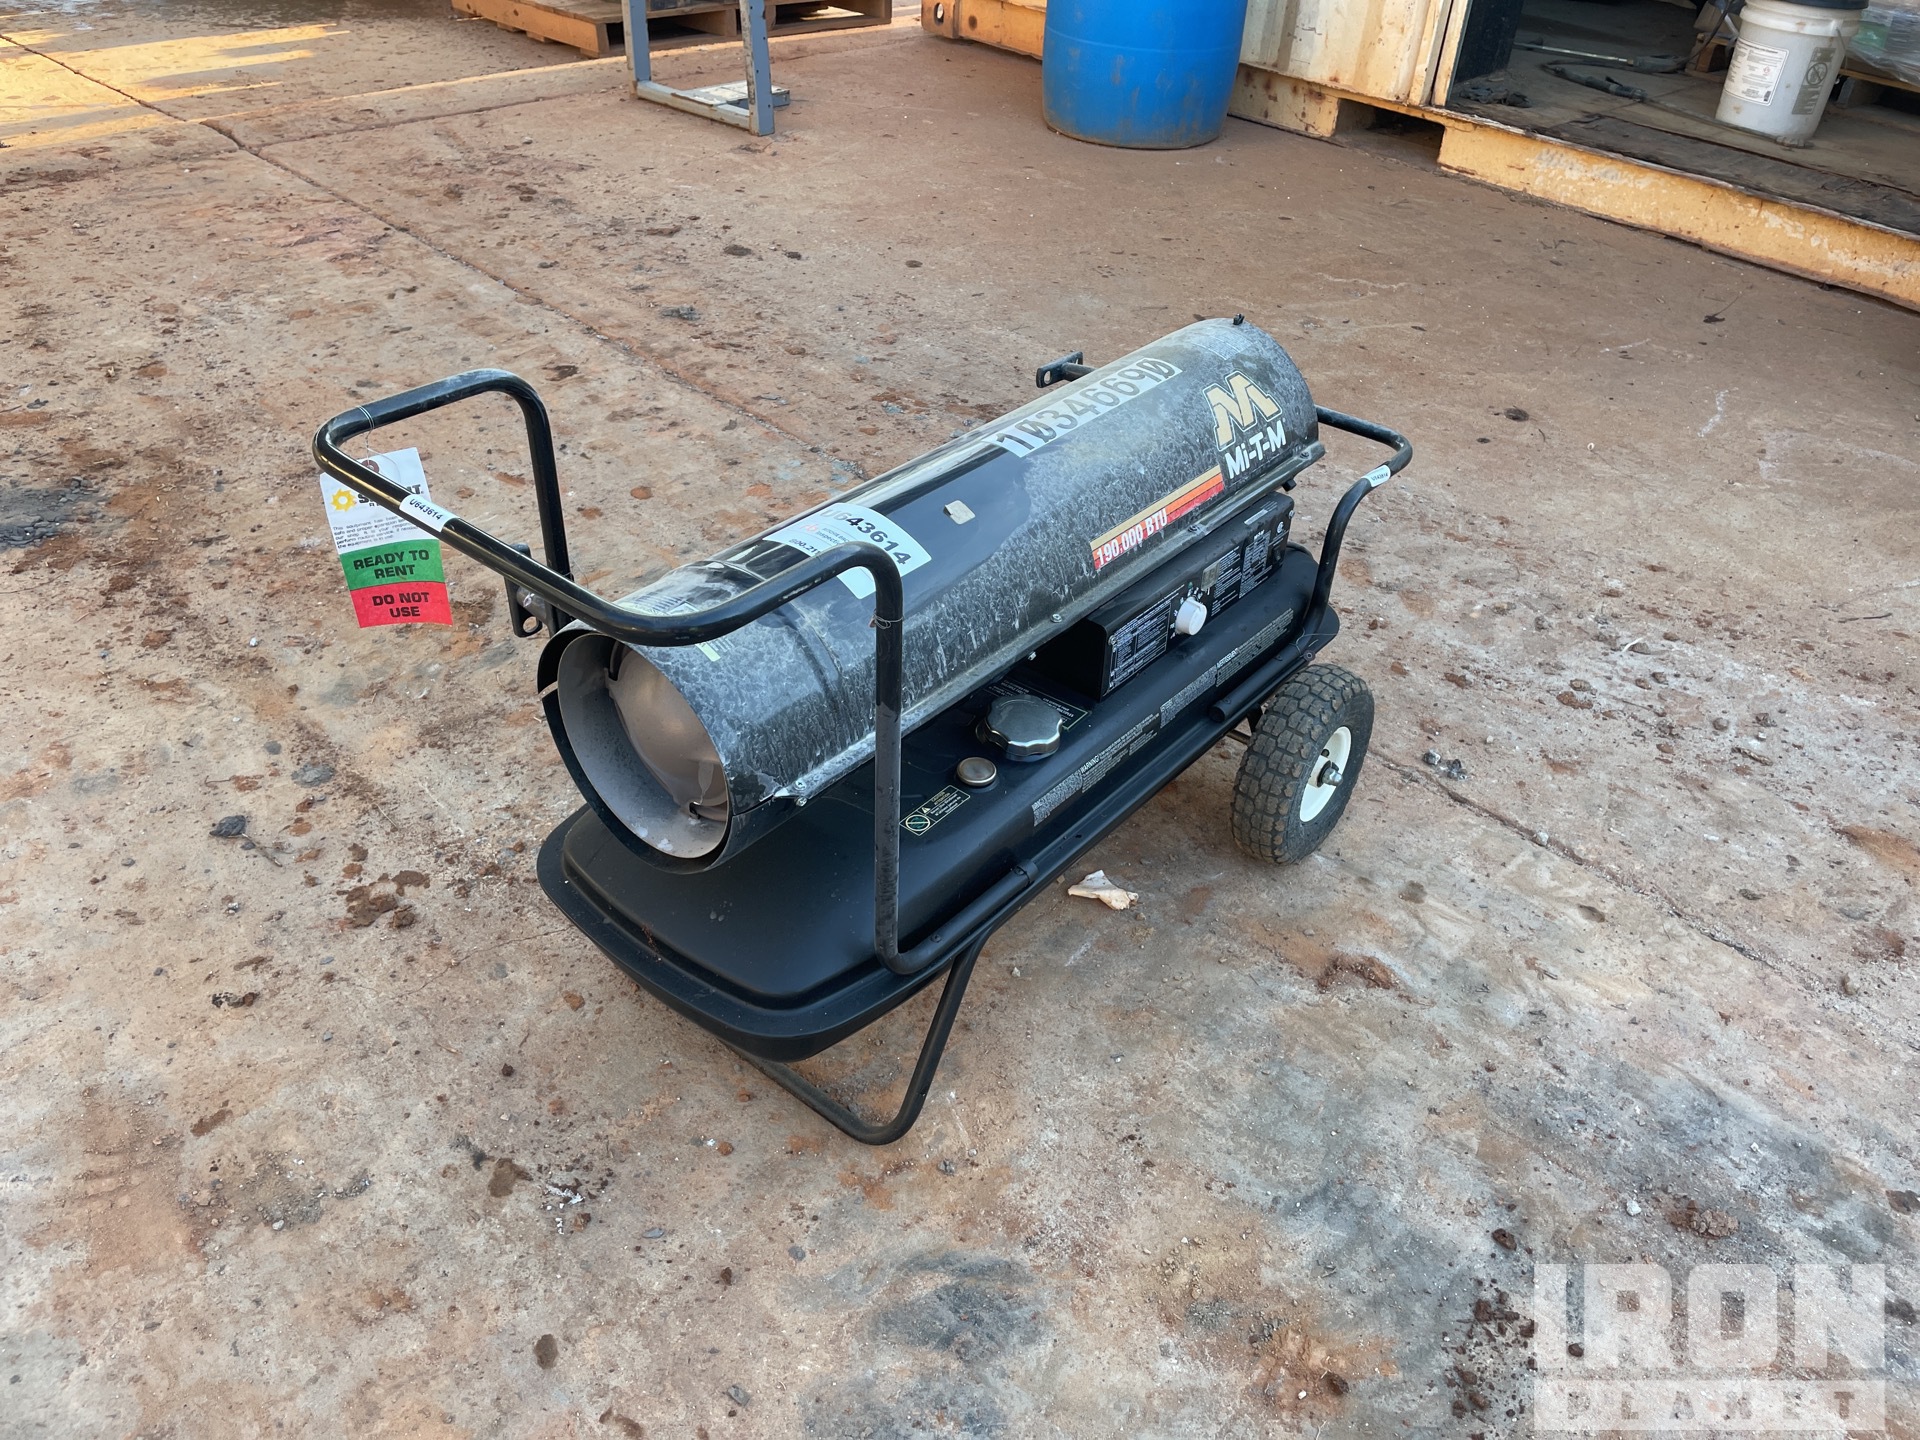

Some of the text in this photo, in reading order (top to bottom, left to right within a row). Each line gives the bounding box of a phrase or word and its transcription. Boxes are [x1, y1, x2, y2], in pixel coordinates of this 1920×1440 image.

[1225, 419, 1287, 479] Mi-T-M
[409, 498, 444, 521] U643614
[820, 509, 912, 565] U643614
[1097, 508, 1168, 566] 190,000 BTU
[353, 549, 430, 571] READY TO
[374, 564, 416, 579] RENT
[372, 592, 430, 607] DO NOT
[389, 606, 421, 618] USE
